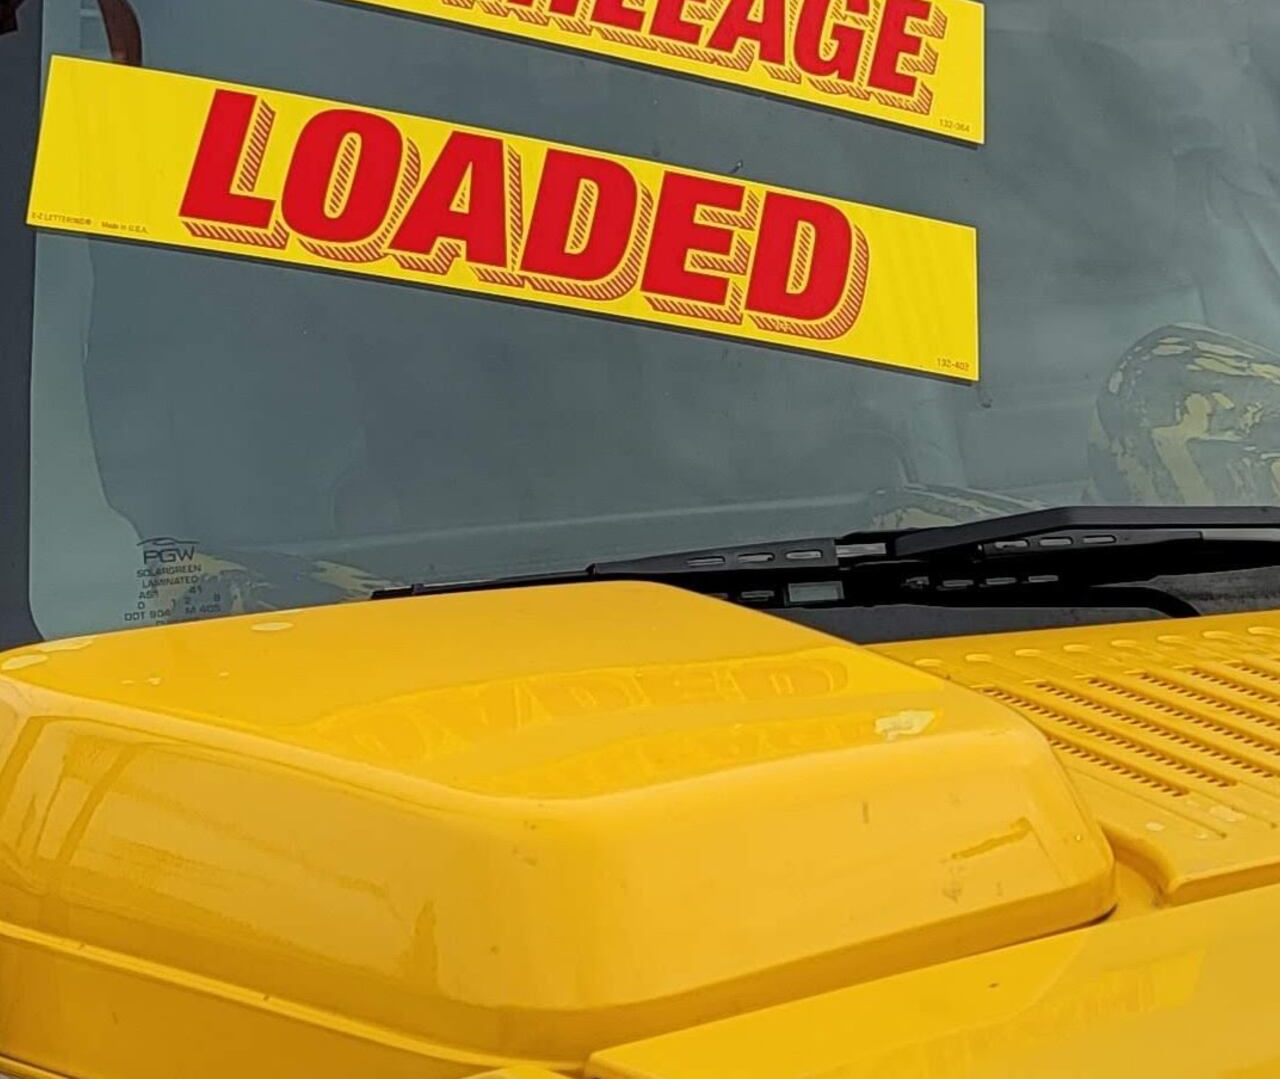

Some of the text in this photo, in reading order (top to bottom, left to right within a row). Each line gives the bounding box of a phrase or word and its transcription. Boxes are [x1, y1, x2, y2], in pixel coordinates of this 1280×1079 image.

[179, 89, 869, 339] LOADED
[143, 546, 195, 564] PGW
[142, 574, 199, 589] LAMINATED
